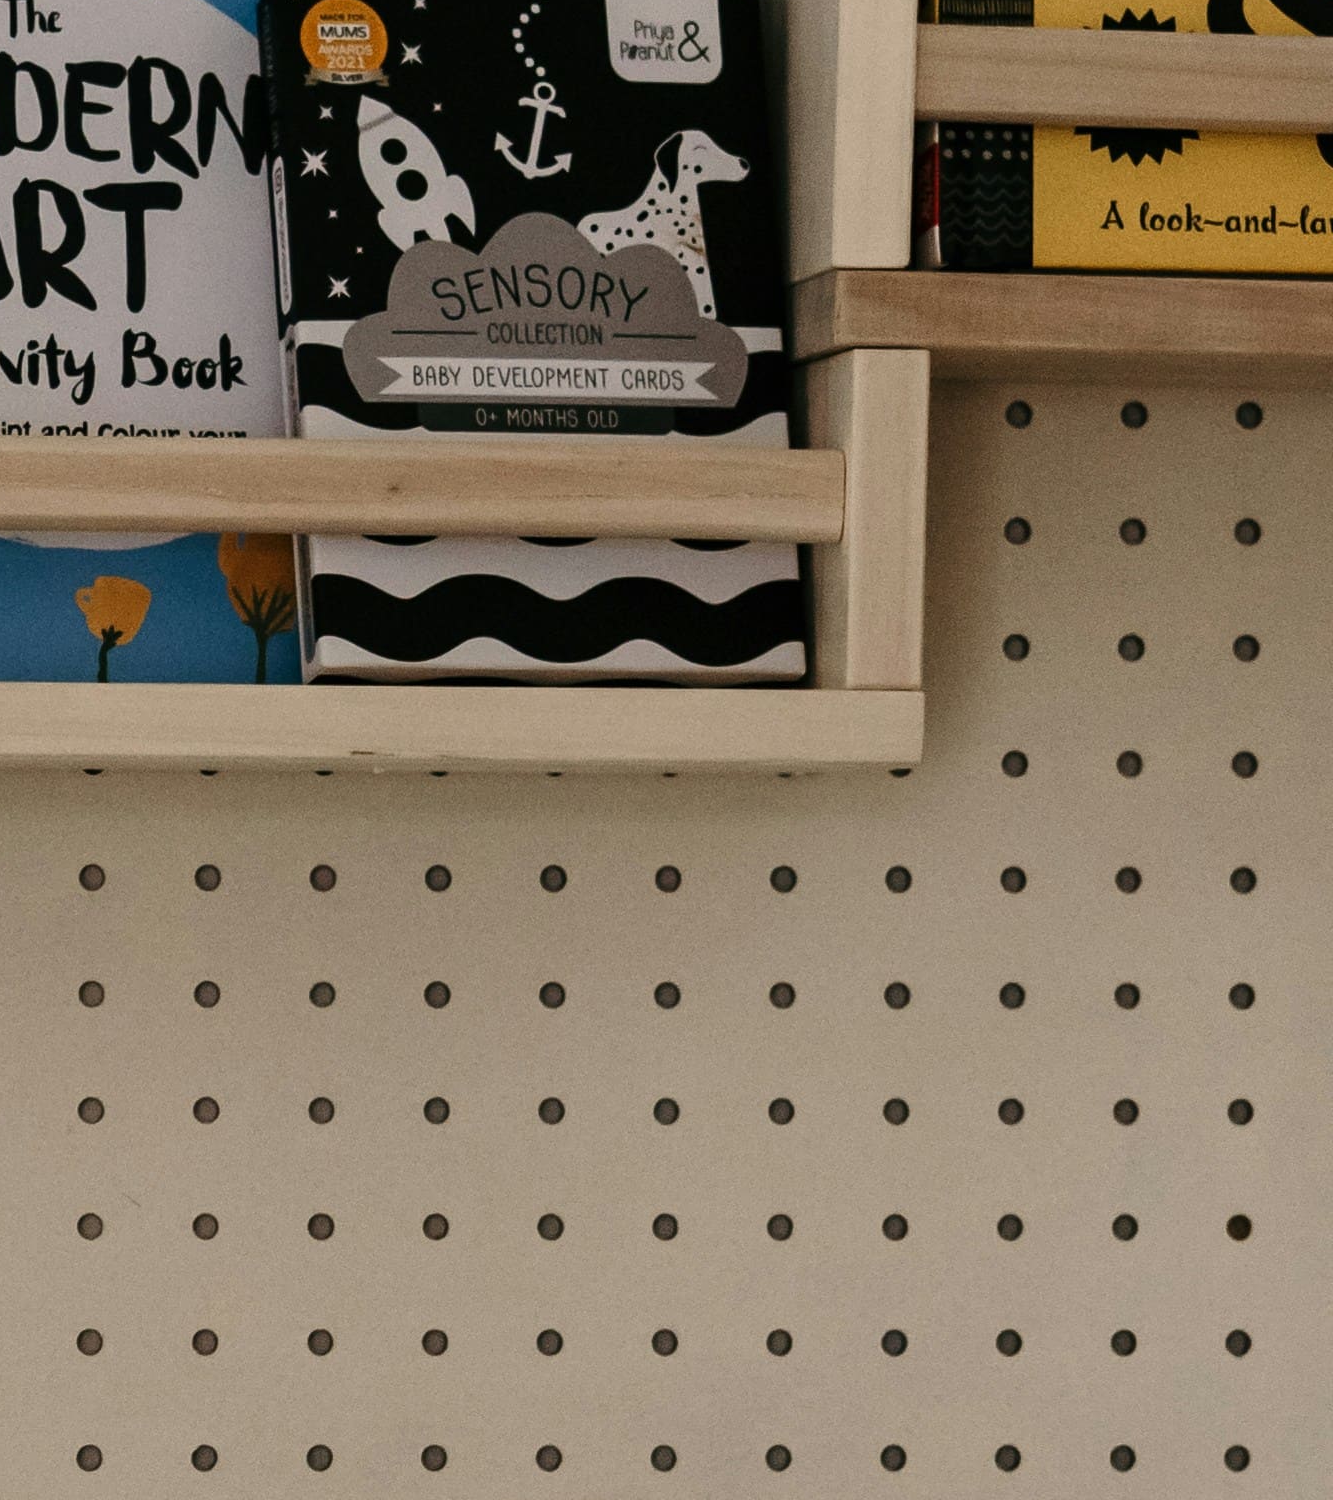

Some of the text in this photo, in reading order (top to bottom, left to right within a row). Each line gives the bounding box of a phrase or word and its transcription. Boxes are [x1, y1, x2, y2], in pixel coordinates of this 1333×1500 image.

[319, 25, 368, 39] MUMS
[634, 19, 675, 46] Priya
[318, 44, 374, 57] AWARDS
[327, 55, 366, 70] 2021
[1100, 200, 1125, 230] A
[432, 263, 650, 323] SENSORY
[486, 322, 604, 346] COLLECTION
[120, 327, 250, 392] Book
[412, 365, 686, 392] BABY DEVELOPMENT CARDS
[475, 408, 620, 429] 0+ MONTHS OLD
